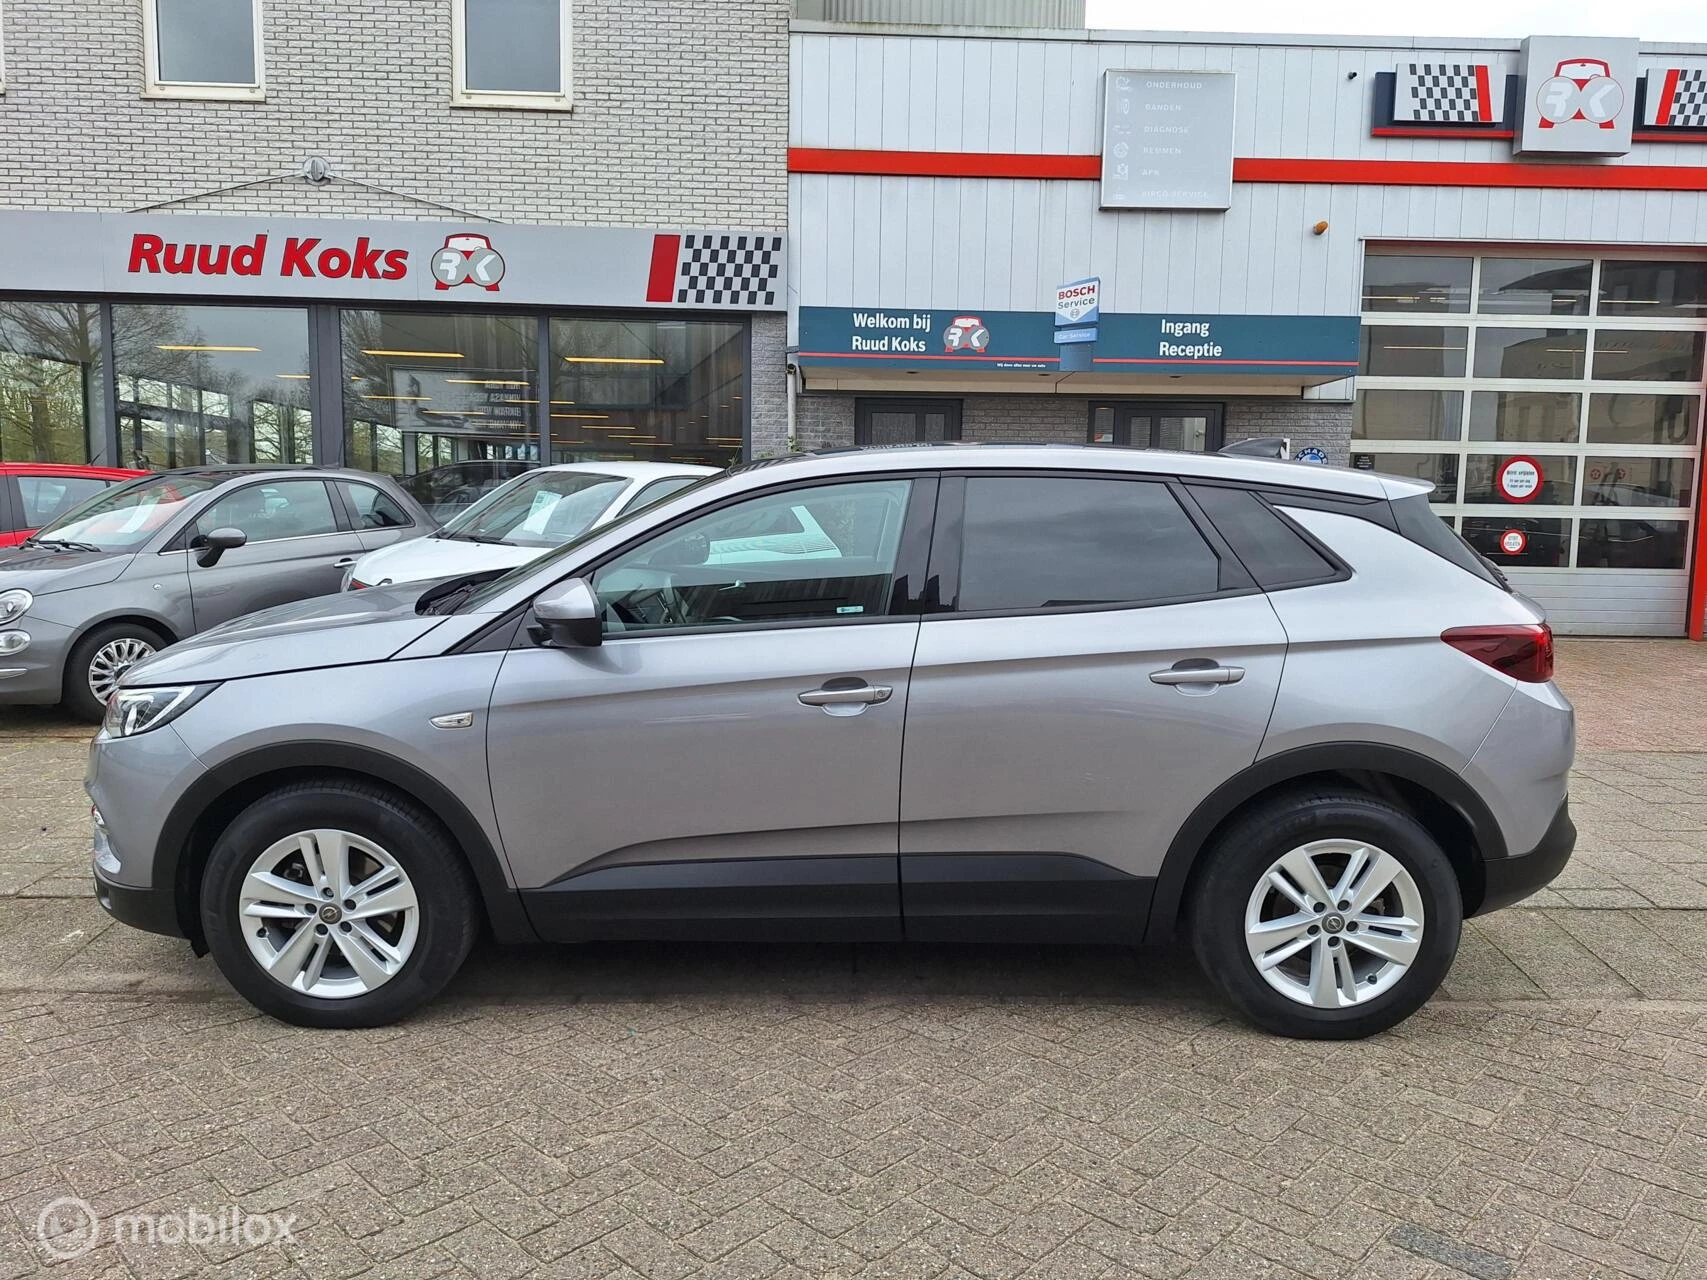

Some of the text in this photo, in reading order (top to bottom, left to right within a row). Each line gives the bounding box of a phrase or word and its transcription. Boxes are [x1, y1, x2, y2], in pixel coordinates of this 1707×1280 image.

[1146, 81, 1203, 89] ONDERHOUD
[127, 233, 409, 281] Ruud Koks
[1058, 284, 1096, 300] BOSCH
[1057, 297, 1096, 310] Service
[853, 313, 931, 332] Welkom bij
[1161, 318, 1210, 337] Ingang
[852, 335, 926, 352] Ruud Koks
[1159, 341, 1223, 360] Receptie
